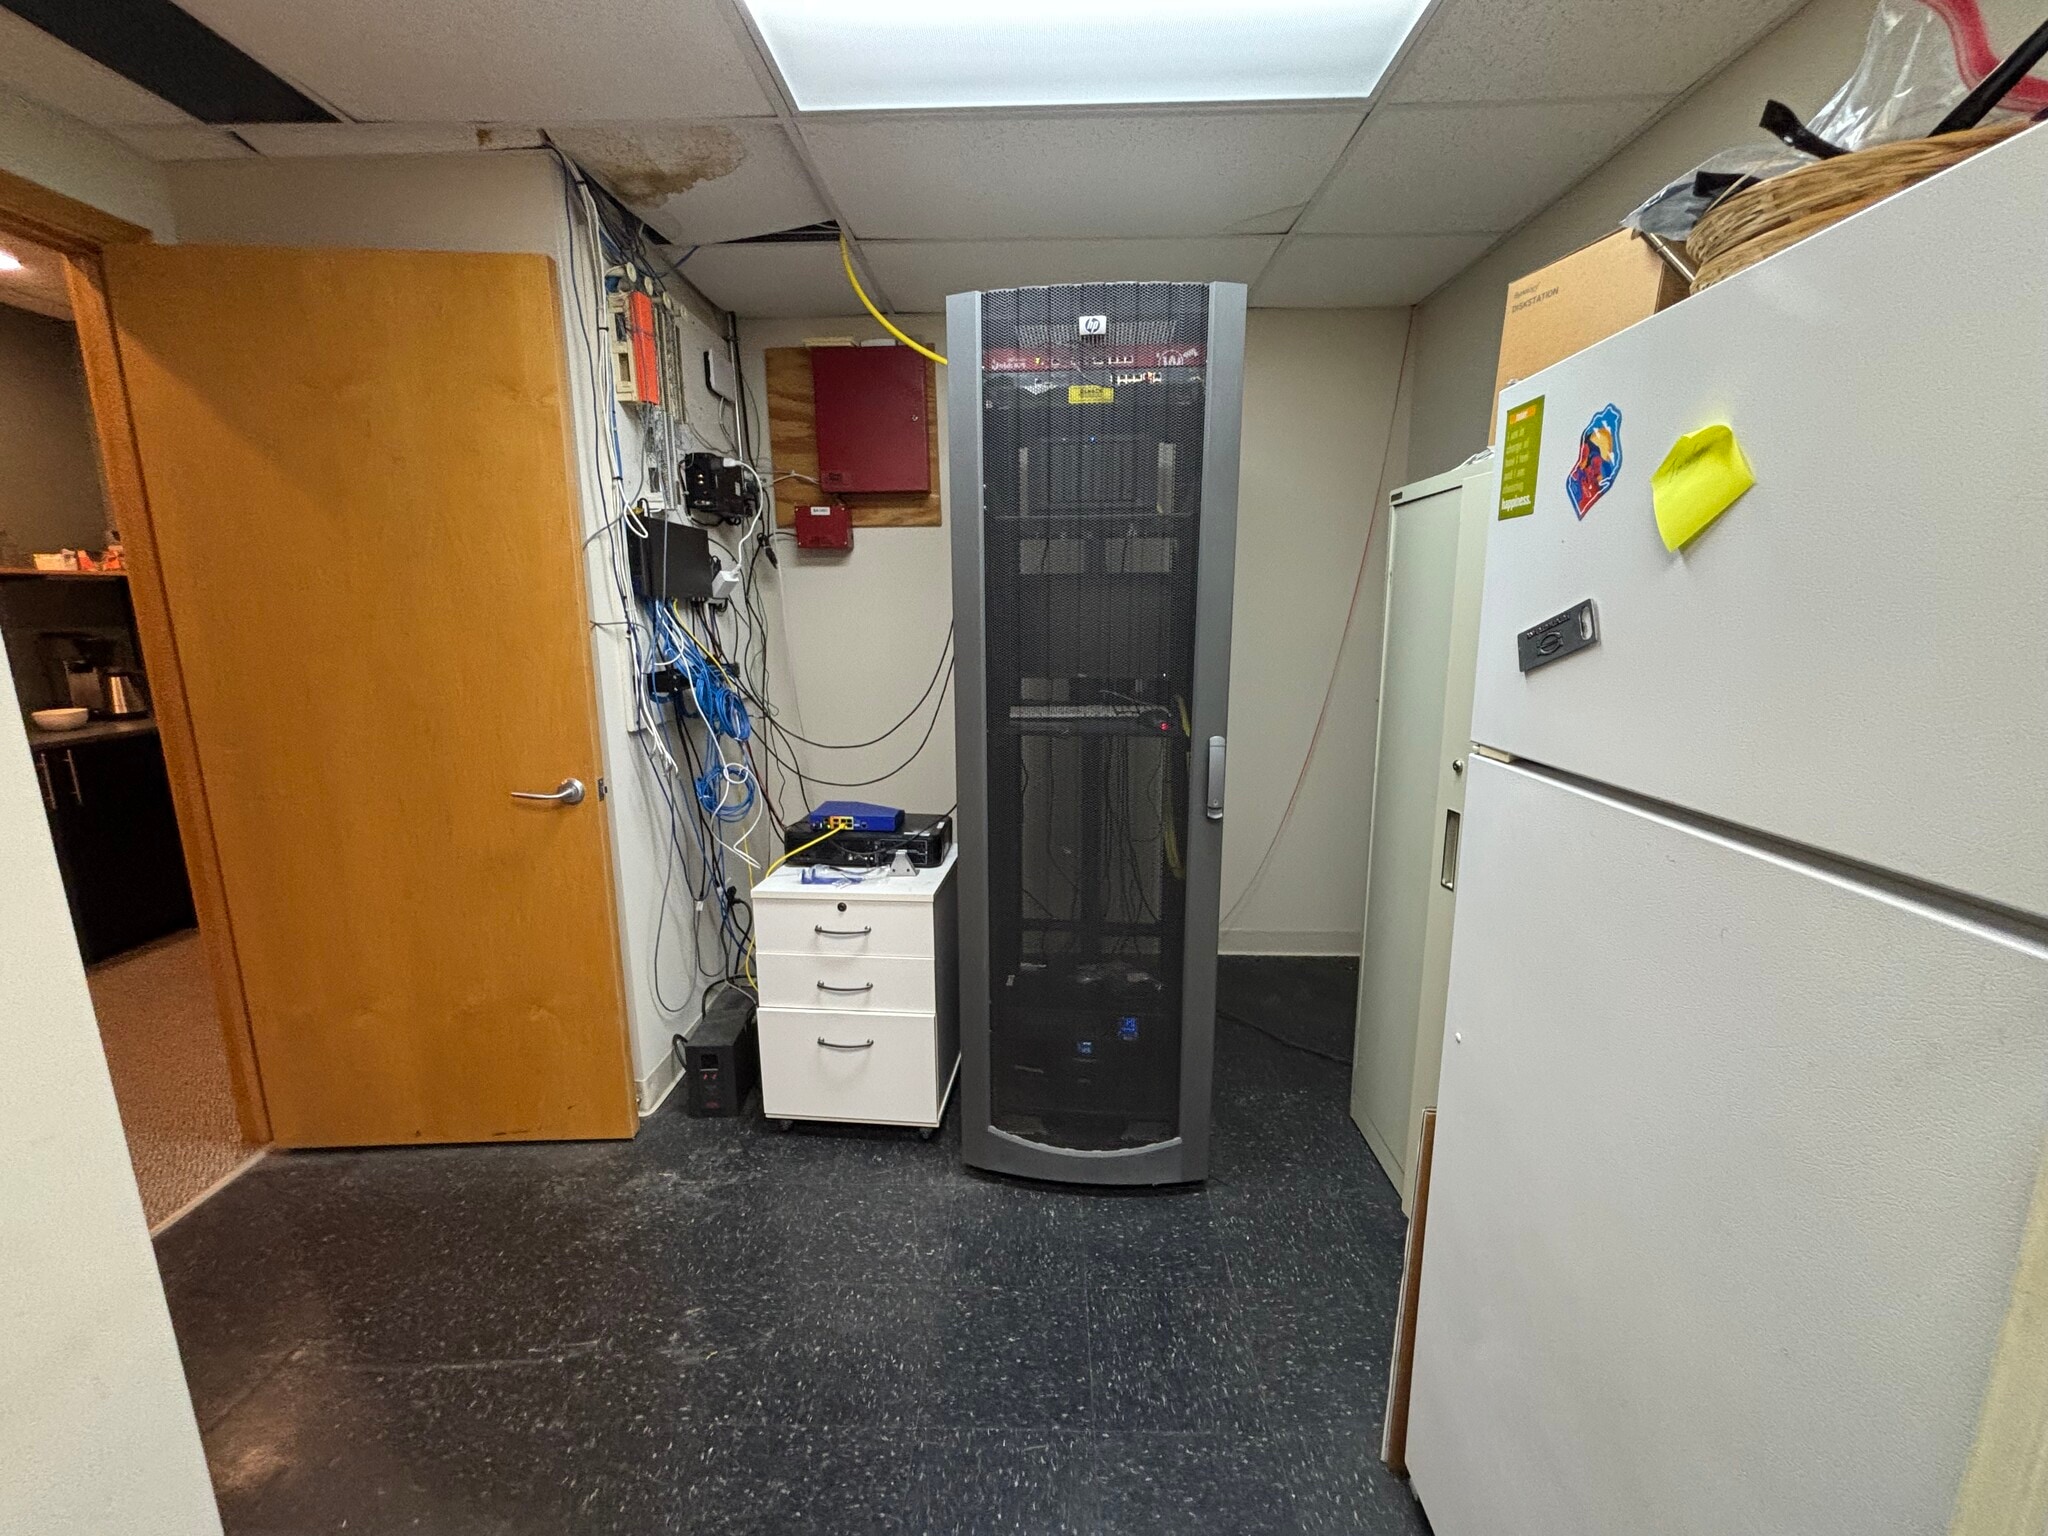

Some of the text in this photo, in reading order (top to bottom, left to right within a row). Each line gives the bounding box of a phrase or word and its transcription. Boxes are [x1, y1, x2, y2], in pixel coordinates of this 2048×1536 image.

[1511, 285, 1559, 313] DISKSTATION
[1085, 316, 1100, 334] hp
[1501, 494, 1531, 512] happiness.
